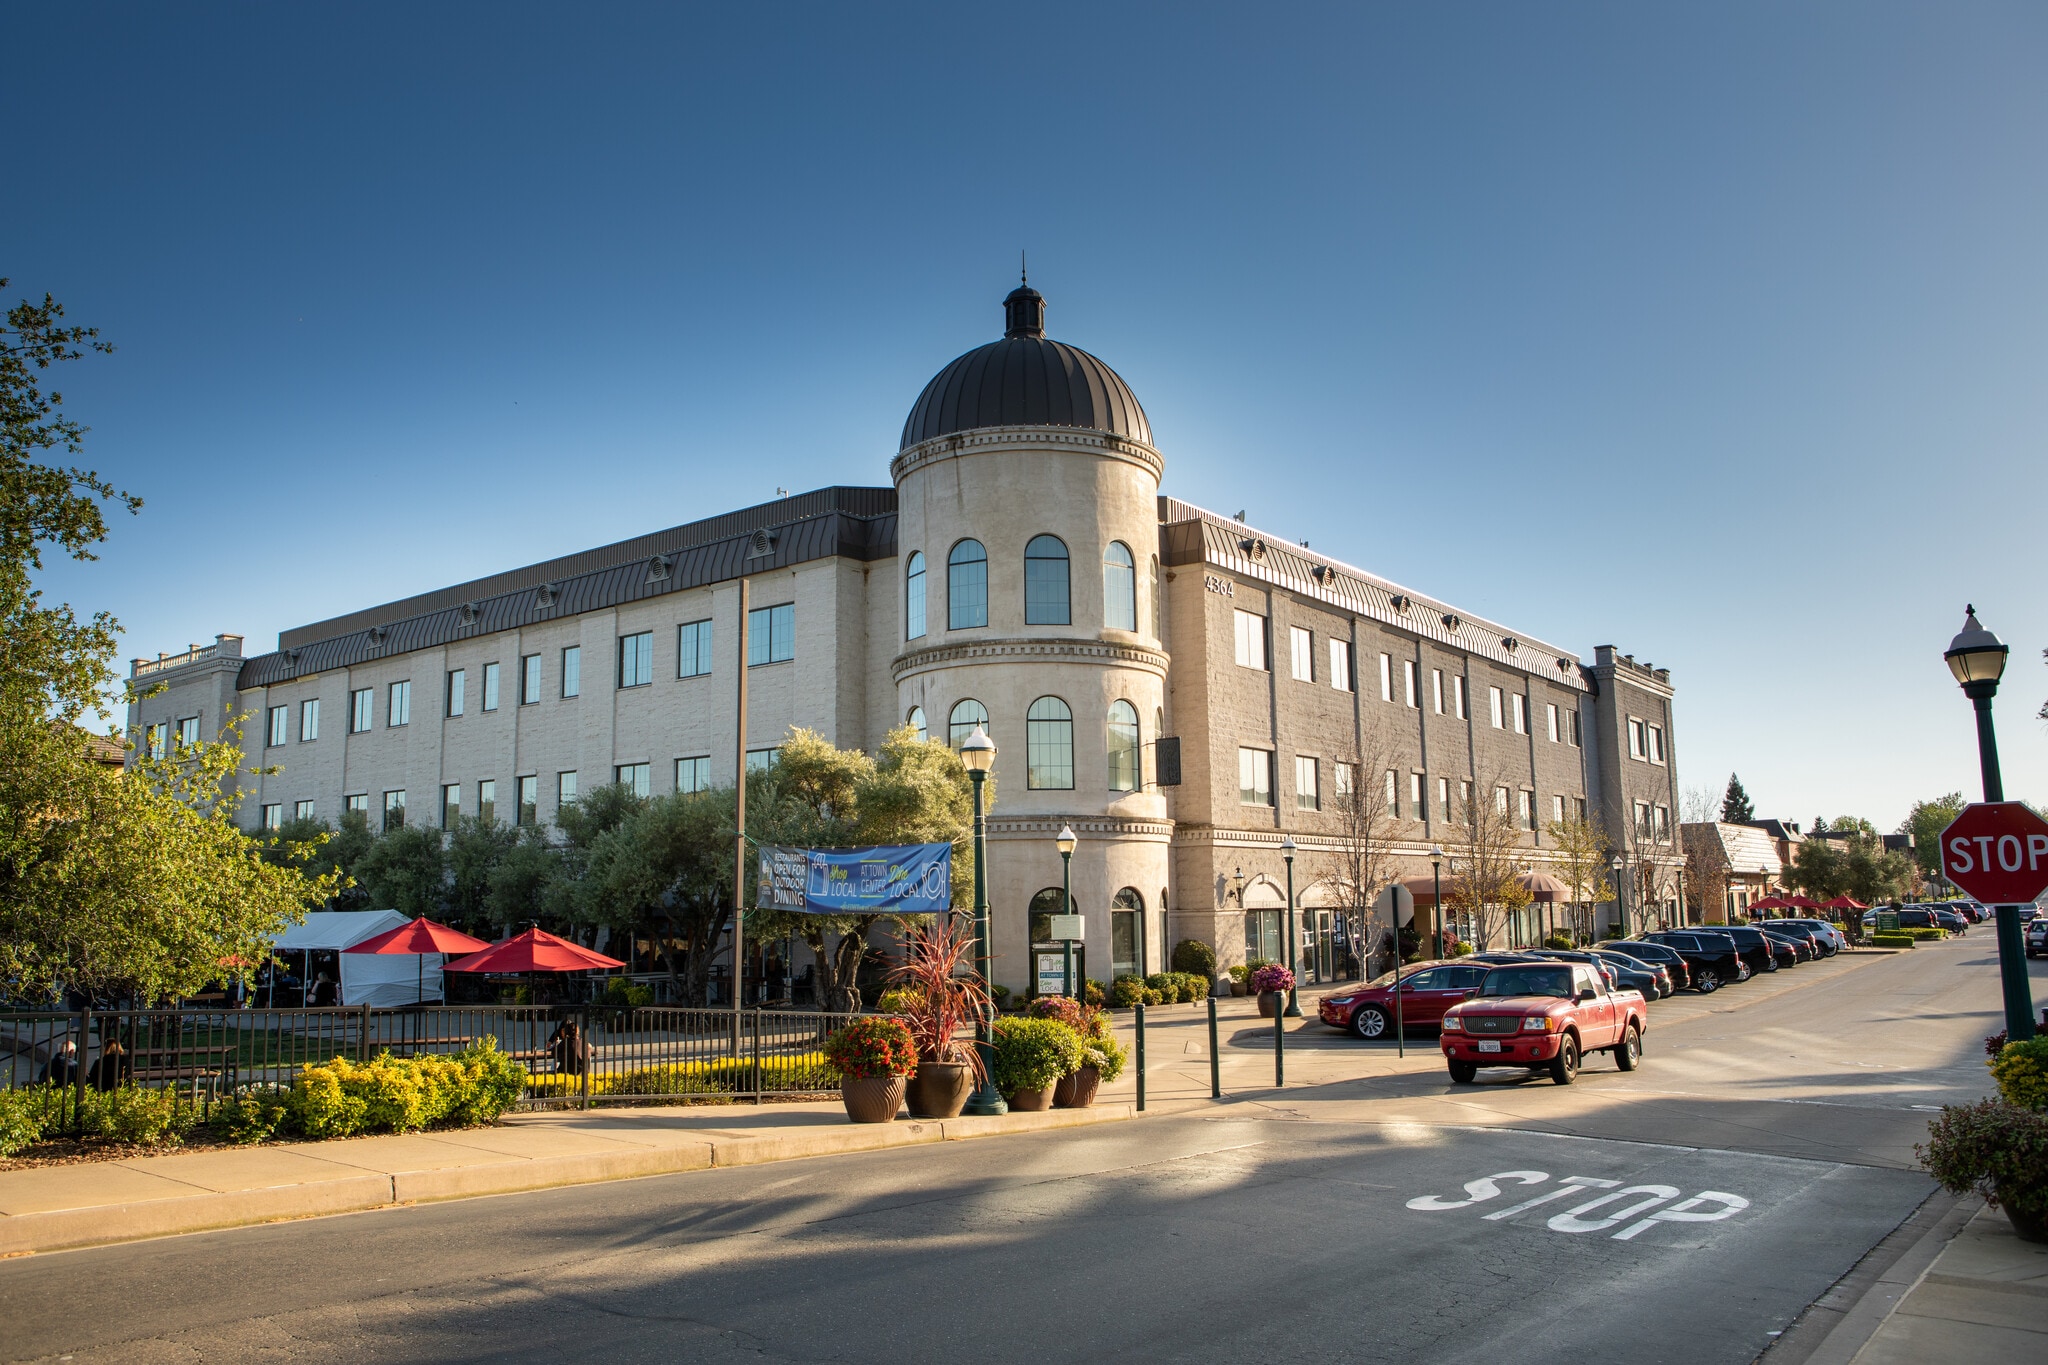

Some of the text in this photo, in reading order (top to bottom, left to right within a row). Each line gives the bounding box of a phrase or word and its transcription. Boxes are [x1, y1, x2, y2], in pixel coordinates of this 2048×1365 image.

[1205, 575, 1234, 598] 4364
[774, 853, 806, 862] RESTAURANTS
[1949, 834, 2048, 873] STOP
[774, 863, 806, 876] OPEN FOR
[829, 864, 848, 883] Shop
[861, 864, 888, 877] AT TOWN
[889, 865, 909, 883] Dine
[775, 877, 805, 889] OUTDOOR
[831, 882, 857, 897] LOCAL
[861, 880, 886, 893] CENTER
[890, 882, 920, 898] LOCAL
[774, 890, 804, 906] DINING
[1405, 1170, 1750, 1240] STOP
